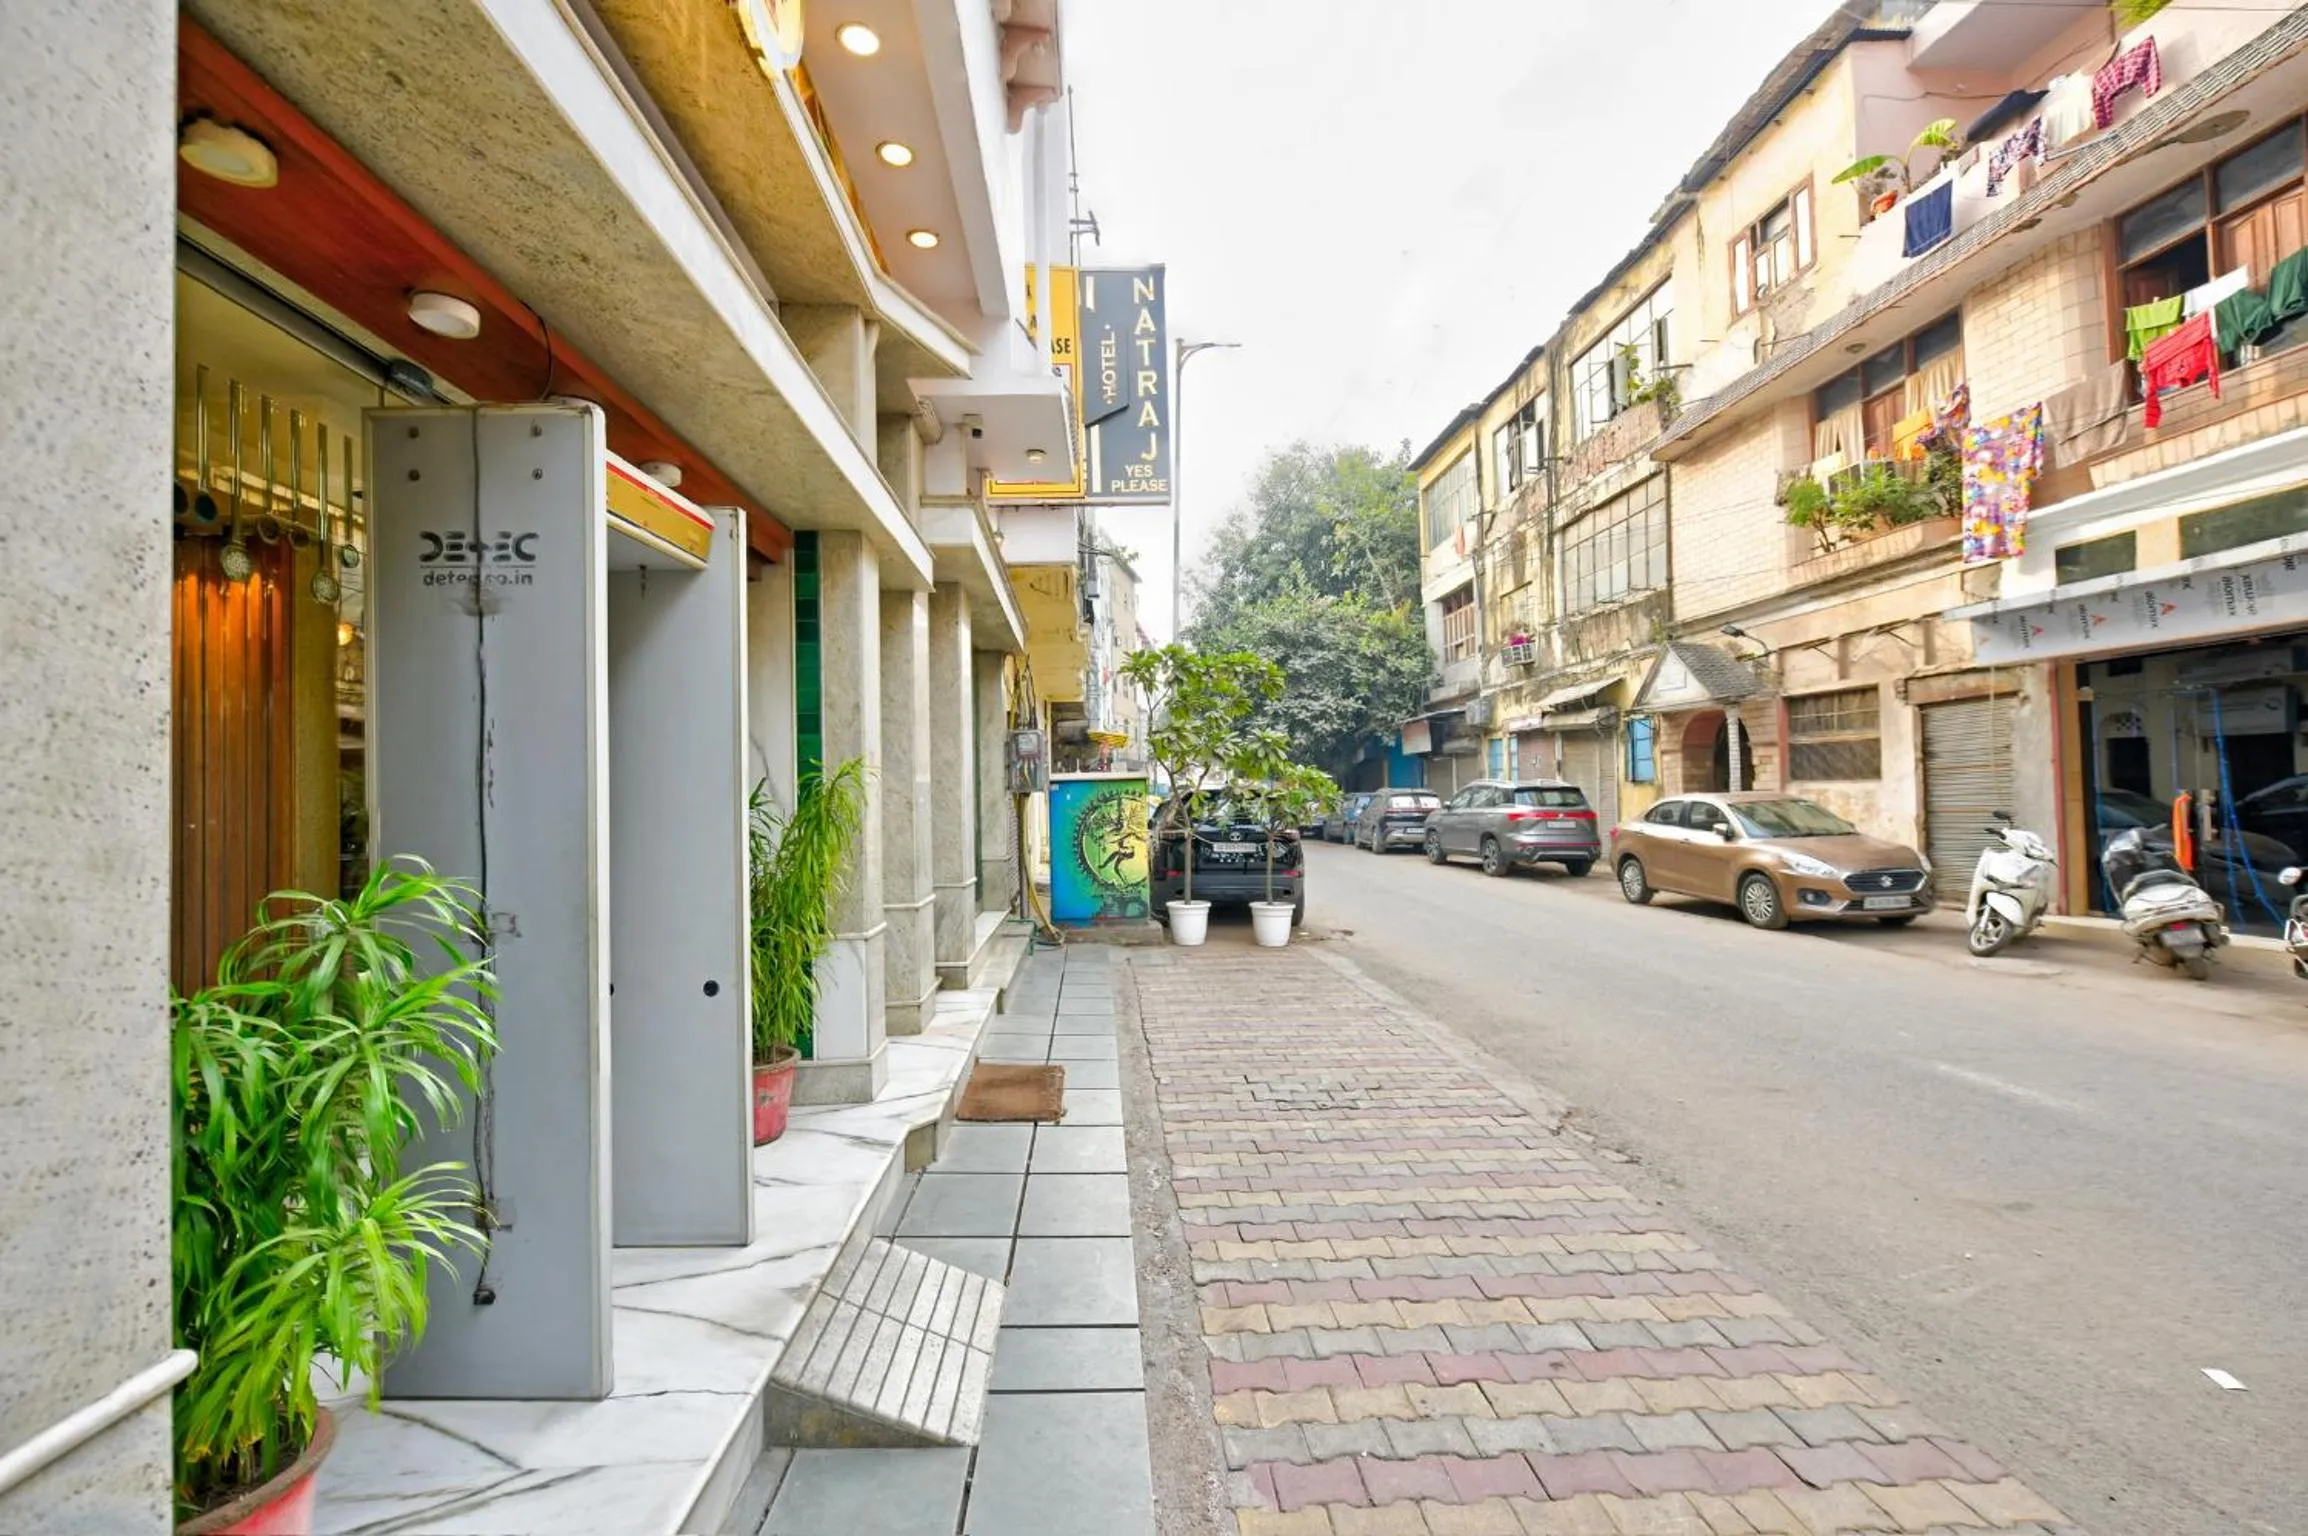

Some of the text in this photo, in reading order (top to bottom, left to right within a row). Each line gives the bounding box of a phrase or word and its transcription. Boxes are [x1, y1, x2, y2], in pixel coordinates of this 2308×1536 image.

[1101, 331, 1117, 398] HOTEL
[1132, 276, 1160, 461] NATRAJ
[1111, 479, 1169, 493] PLEASE
[1124, 464, 1153, 478] YES
